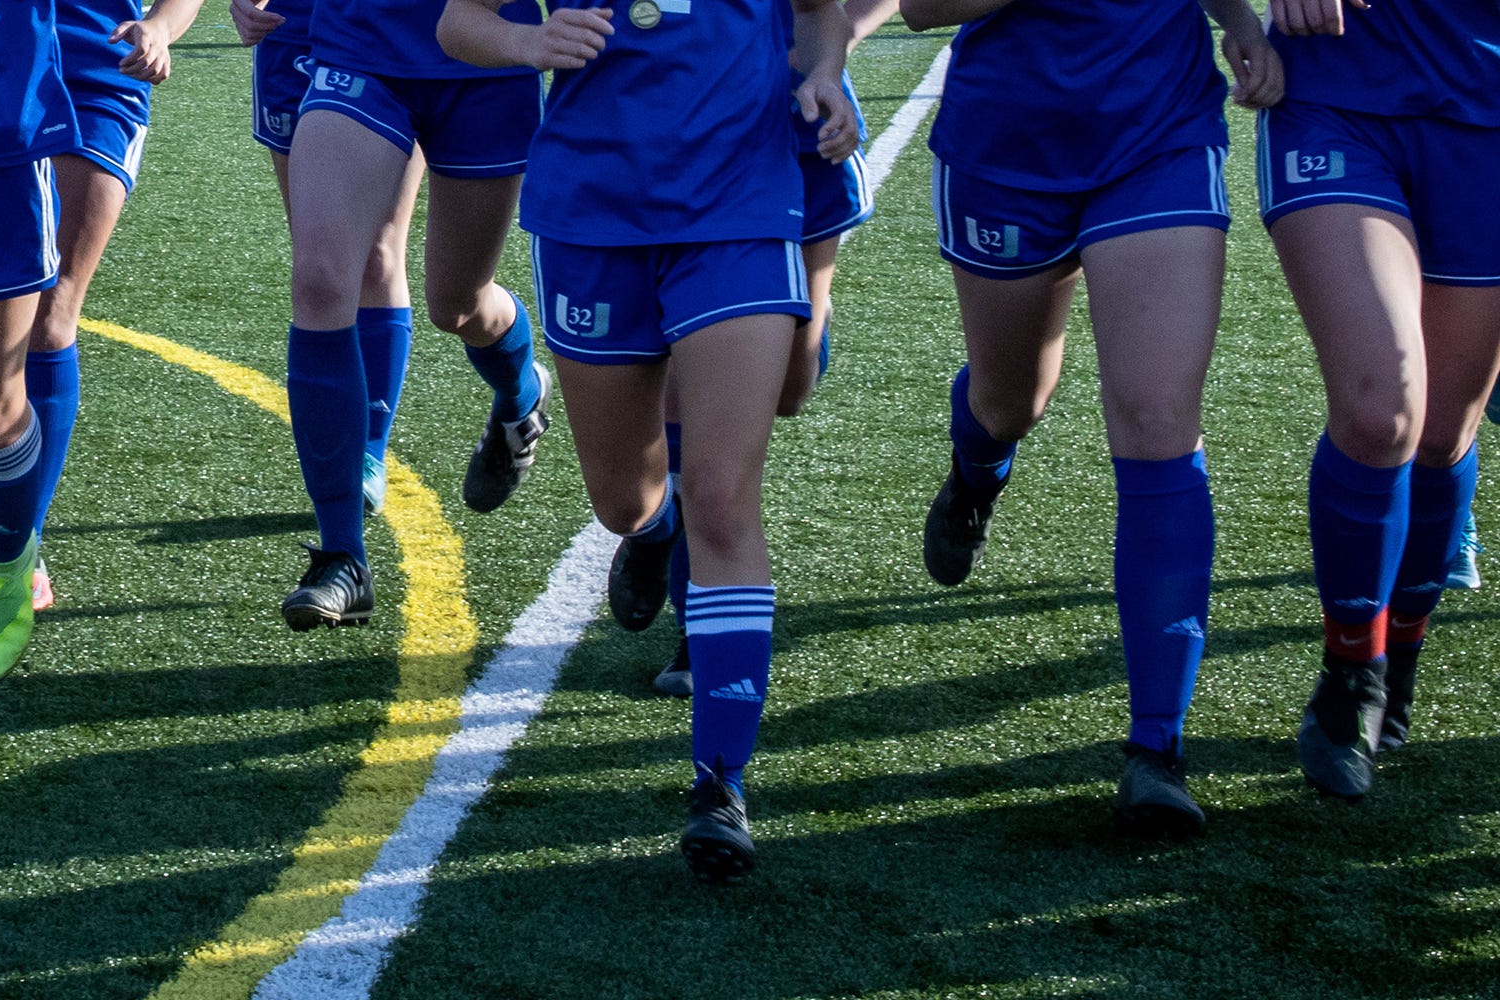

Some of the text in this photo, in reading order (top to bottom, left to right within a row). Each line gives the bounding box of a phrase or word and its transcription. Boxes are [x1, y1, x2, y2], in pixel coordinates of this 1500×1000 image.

[328, 71, 351, 87] 32
[1300, 155, 1326, 172] 32
[979, 229, 1001, 247] 32
[568, 306, 591, 326] 32
